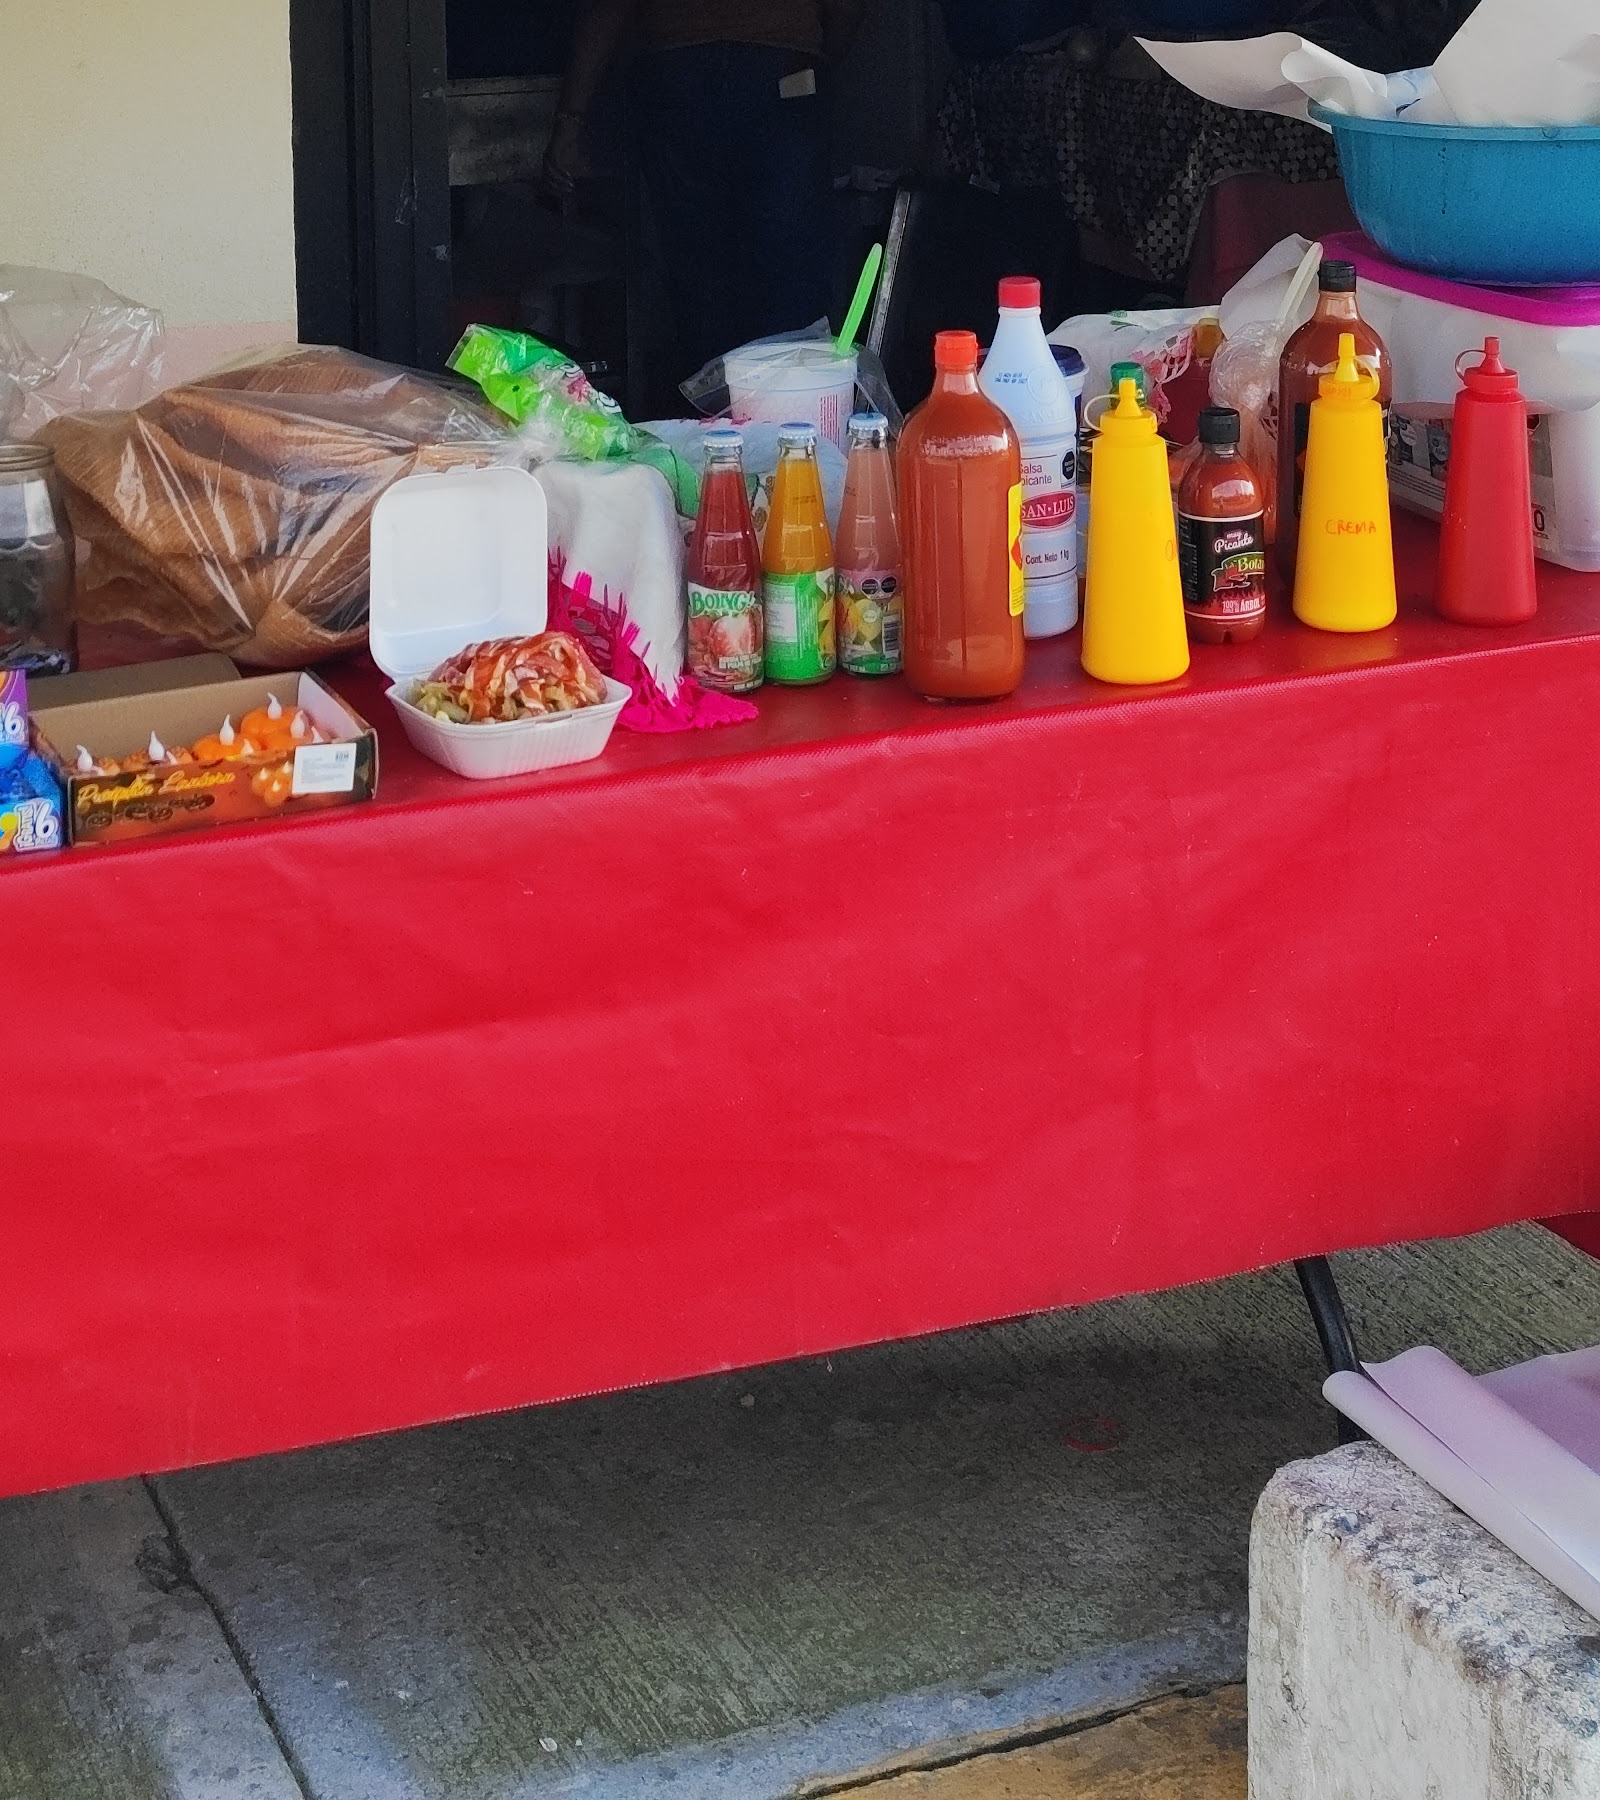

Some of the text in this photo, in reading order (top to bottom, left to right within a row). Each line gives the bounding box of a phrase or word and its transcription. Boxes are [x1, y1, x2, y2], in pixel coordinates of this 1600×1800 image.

[1325, 519, 1377, 536] CREMA
[1214, 532, 1254, 554] Picante
[4, 702, 24, 735] 6
[34, 800, 58, 839] 6
